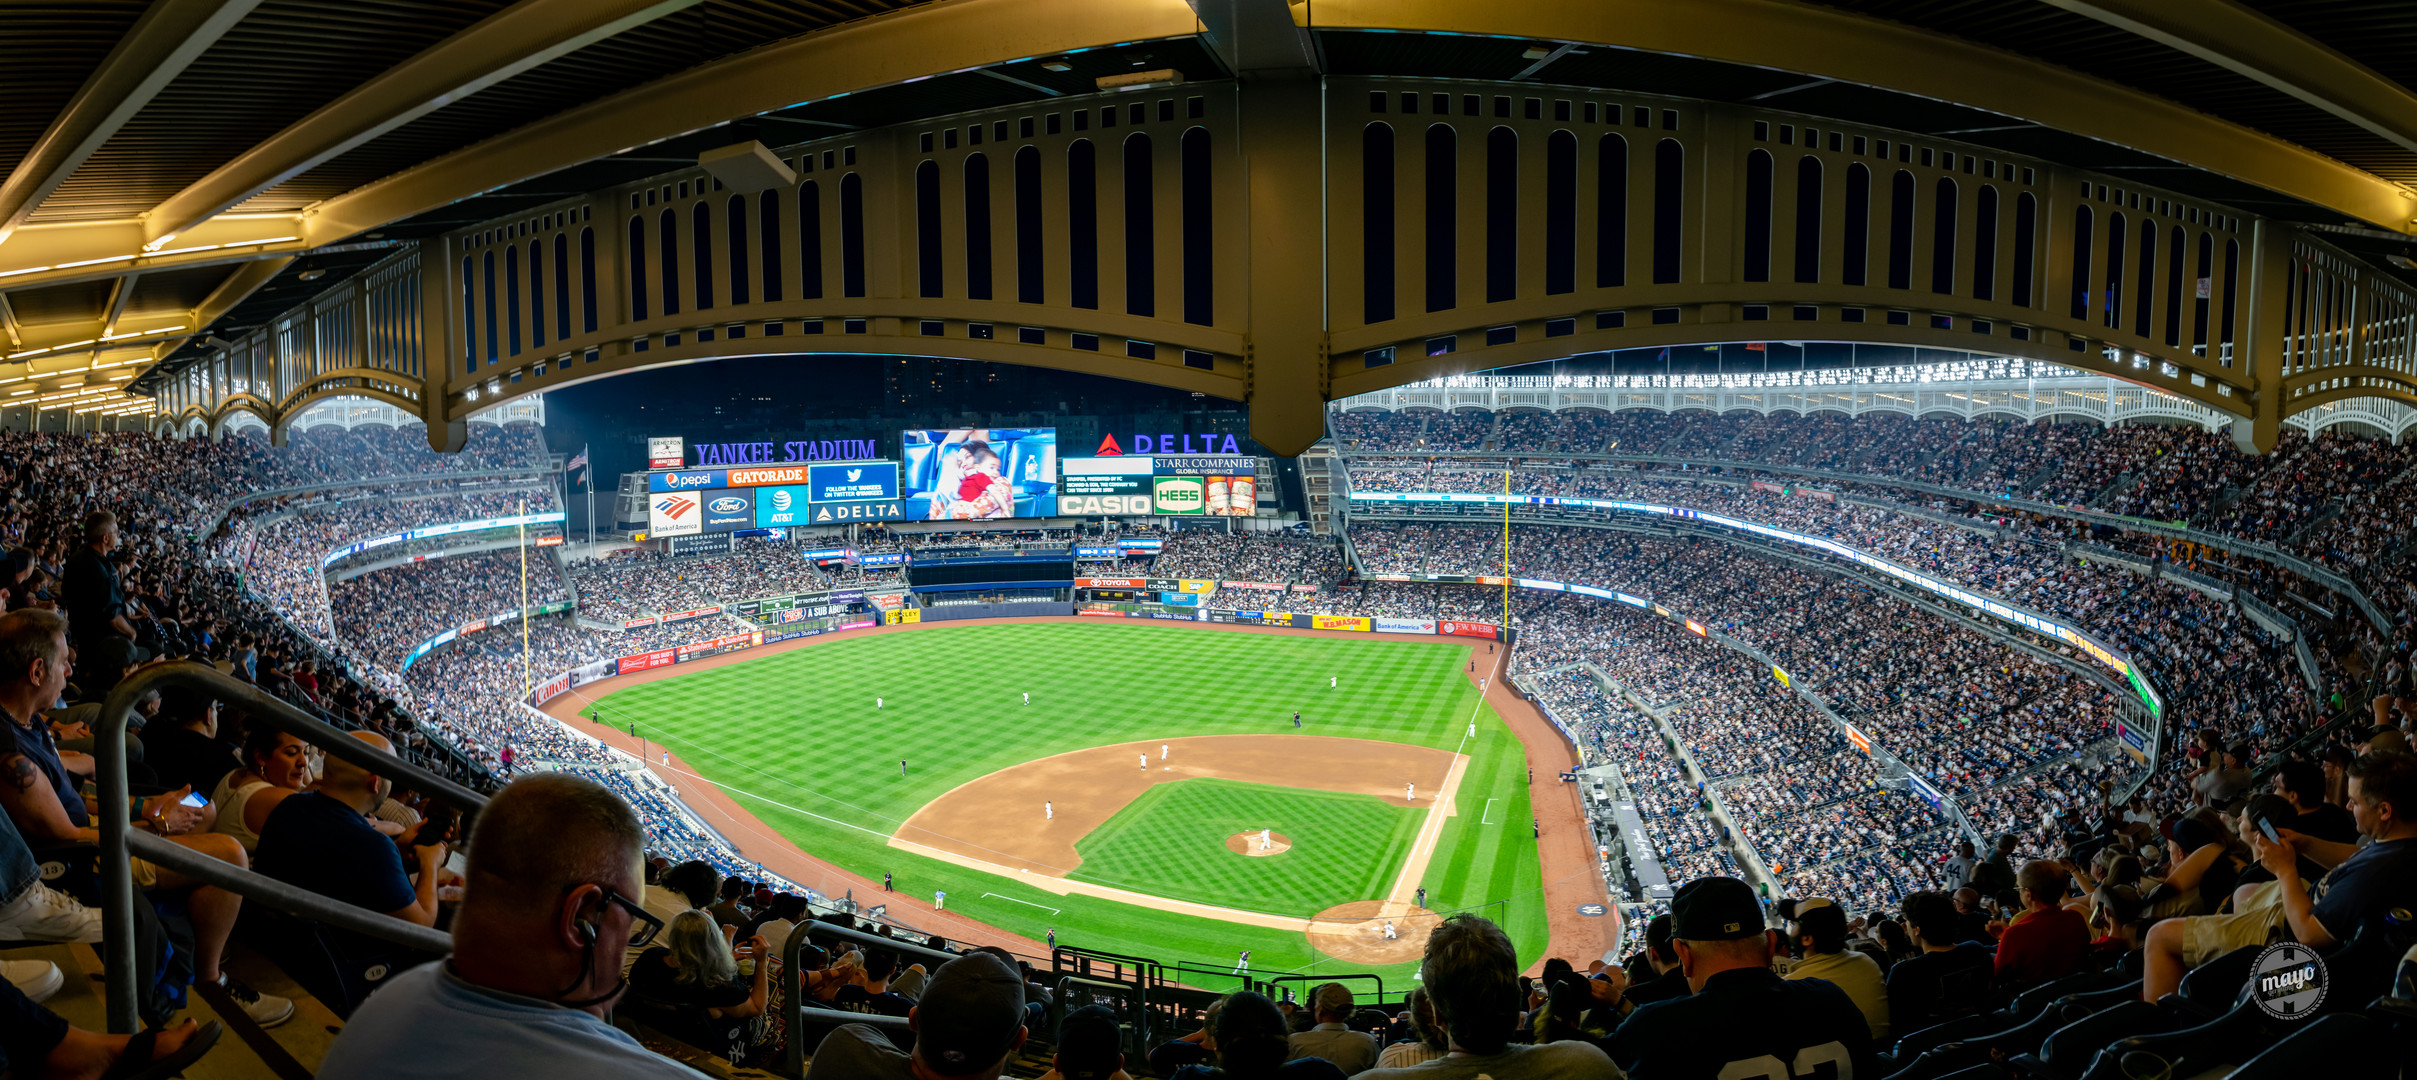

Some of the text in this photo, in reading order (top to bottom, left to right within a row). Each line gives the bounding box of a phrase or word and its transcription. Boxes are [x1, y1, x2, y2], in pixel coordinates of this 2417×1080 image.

[1134, 434, 1239, 454] DELTA
[694, 439, 876, 466] YANKEE STADIUM
[1155, 459, 1254, 468] STARR COMPANIES
[680, 473, 712, 488] pepsi
[732, 469, 803, 484] GATORADE
[1159, 490, 1199, 501] HESS
[716, 500, 741, 511] Ford
[837, 504, 900, 519] DELTA
[1061, 496, 1151, 514] CASIO
[771, 513, 794, 523] AT&T
[808, 604, 848, 617] A SUB ABOVE
[1470, 624, 1493, 633] WEBB
[537, 677, 569, 703] Canon
[44, 865, 58, 875] 13
[1946, 863, 1961, 879] 44
